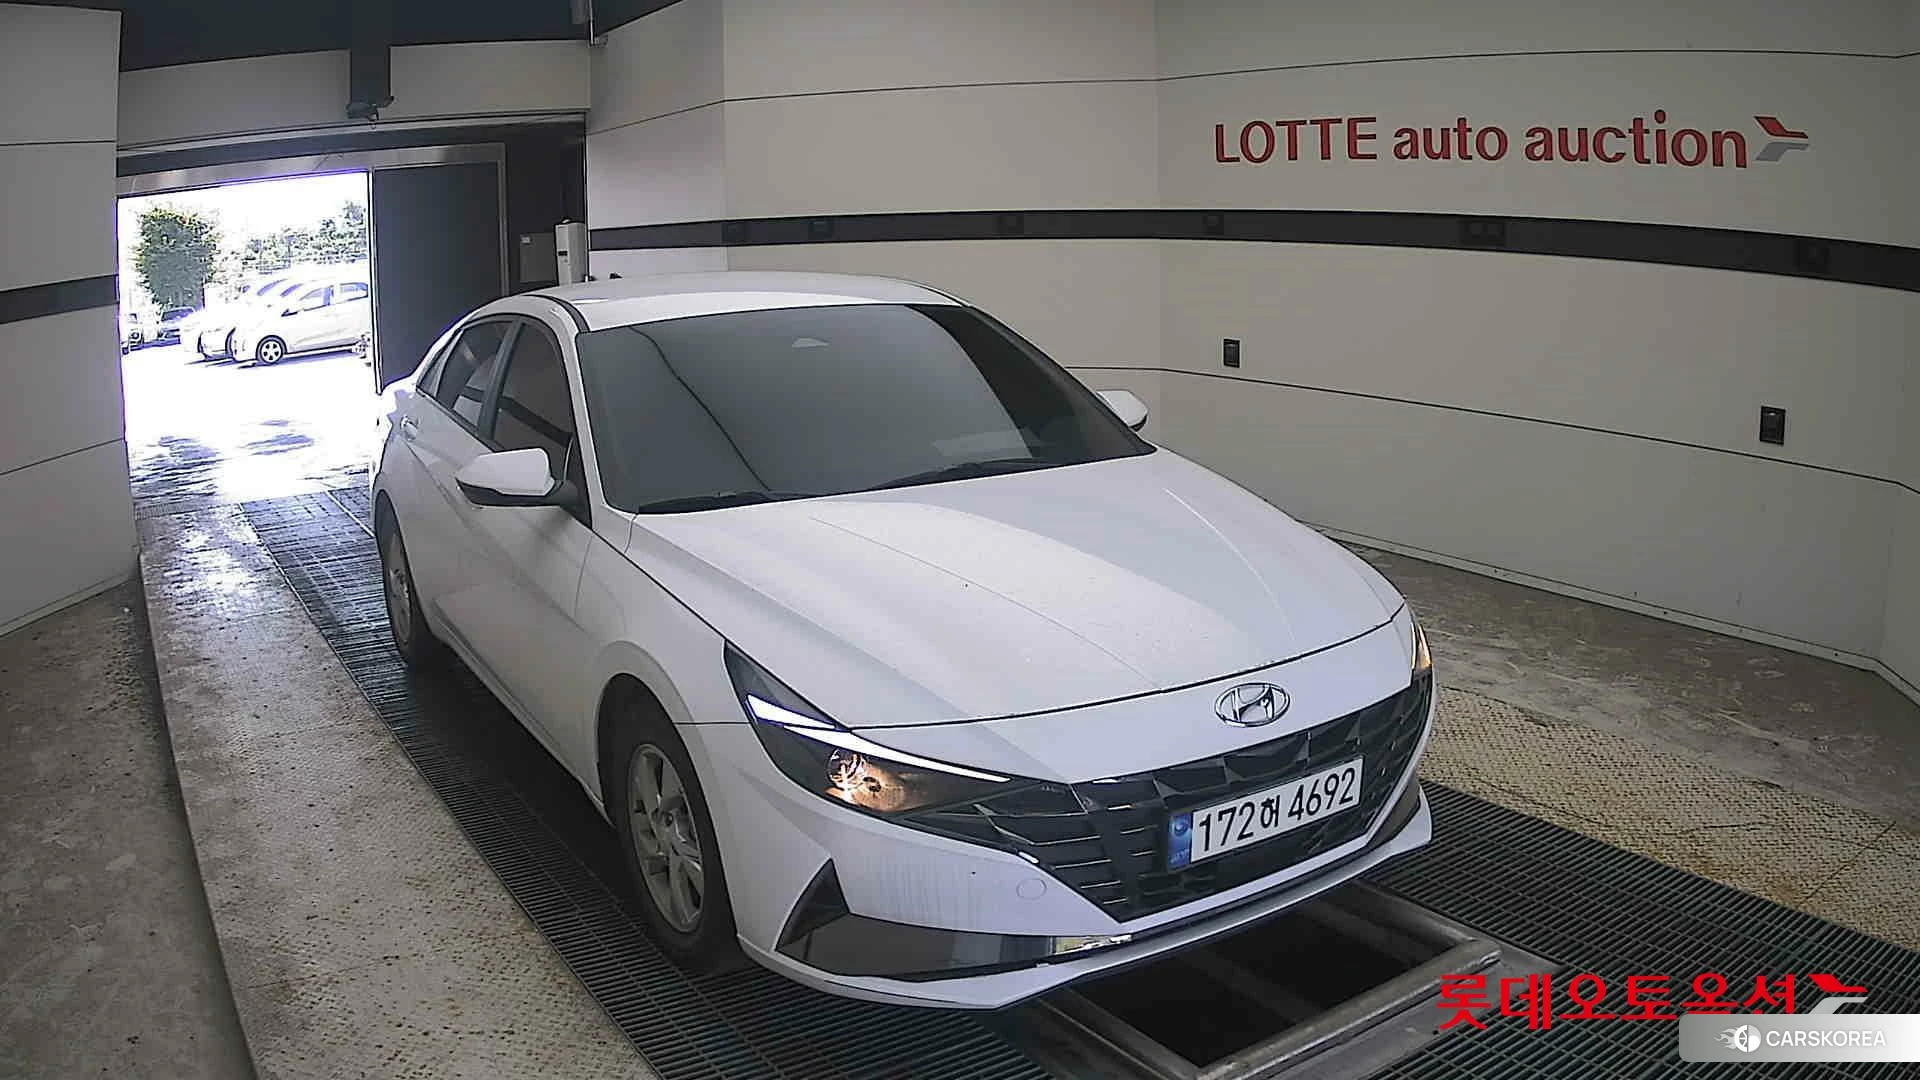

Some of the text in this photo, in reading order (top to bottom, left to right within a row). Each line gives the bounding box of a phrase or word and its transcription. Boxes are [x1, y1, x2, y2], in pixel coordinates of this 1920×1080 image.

[1215, 110, 1747, 168] LOTTE auto auction
[1199, 767, 1356, 852] 172허 4692
